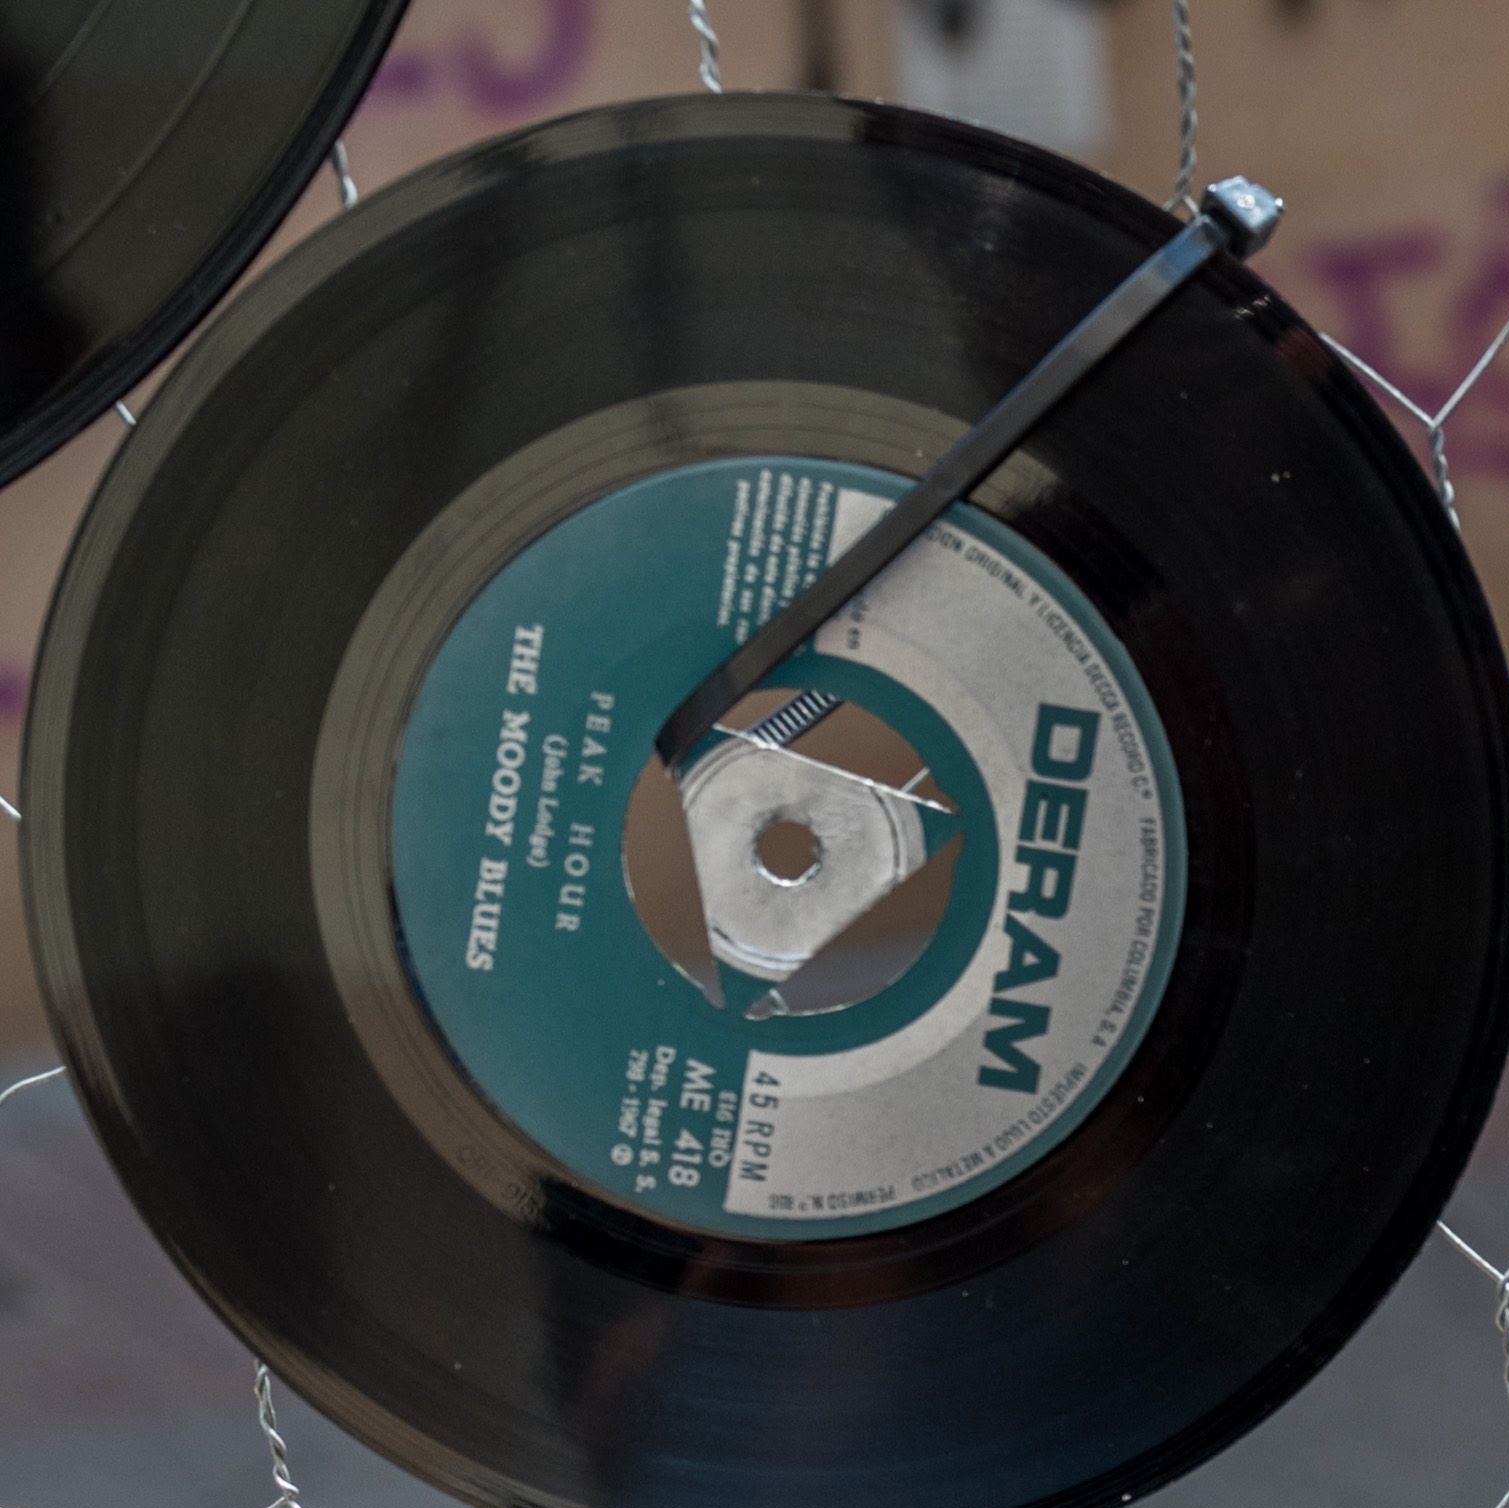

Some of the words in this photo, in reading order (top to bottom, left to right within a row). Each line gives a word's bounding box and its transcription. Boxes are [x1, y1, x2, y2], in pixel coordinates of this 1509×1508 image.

[505, 623, 546, 696] THE
[539, 732, 570, 794] (John
[576, 689, 617, 787] PEAK
[484, 709, 532, 847] MOODY
[524, 795, 560, 869] Lodge)
[553, 821, 596, 933] HOUR
[975, 701, 1102, 1096] DERAM
[464, 856, 509, 972] BLUES
[648, 1043, 678, 1092] Dep.
[678, 1057, 717, 1113] ME
[747, 1070, 783, 1112] 45
[641, 1097, 669, 1147] legal
[738, 1118, 777, 1184] RPM
[666, 1128, 704, 1189] 418
